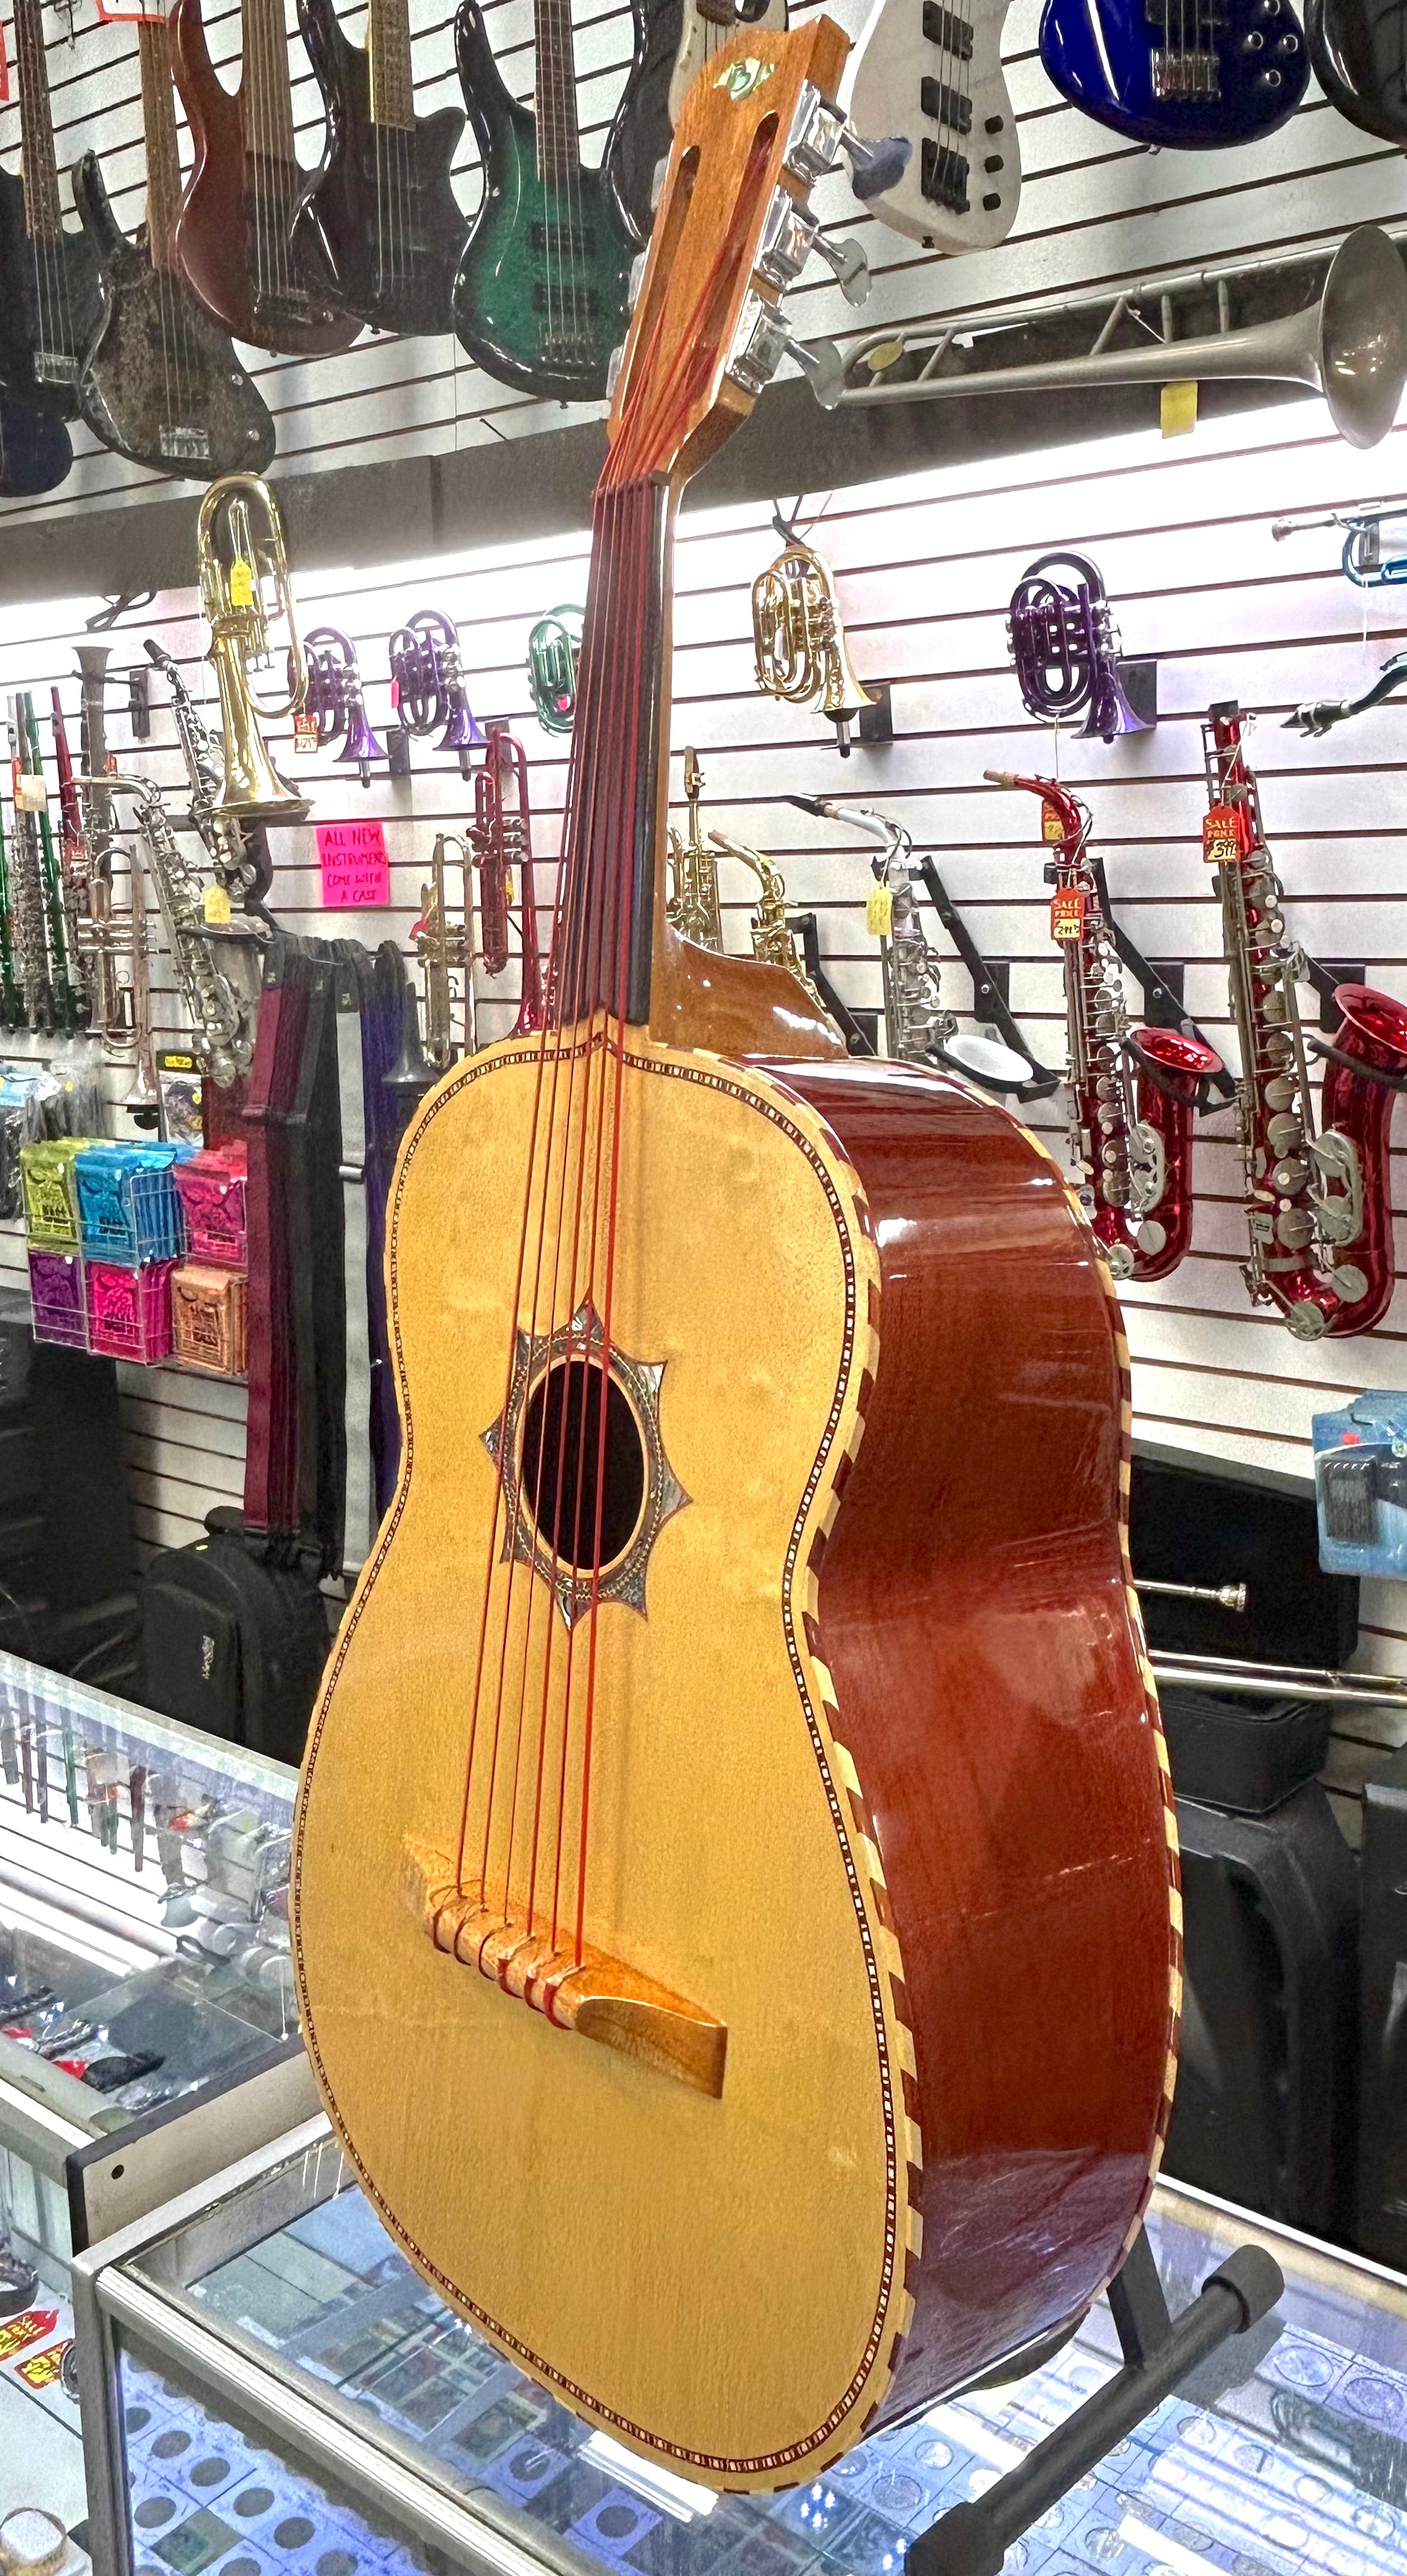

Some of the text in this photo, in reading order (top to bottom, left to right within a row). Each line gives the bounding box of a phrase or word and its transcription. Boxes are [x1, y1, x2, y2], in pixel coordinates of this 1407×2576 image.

[1205, 817, 1238, 830] SALE
[325, 828, 380, 846] ALL NEW
[327, 872, 382, 887] COME WITH
[341, 890, 348, 903] A
[1052, 898, 1081, 910] SALE
